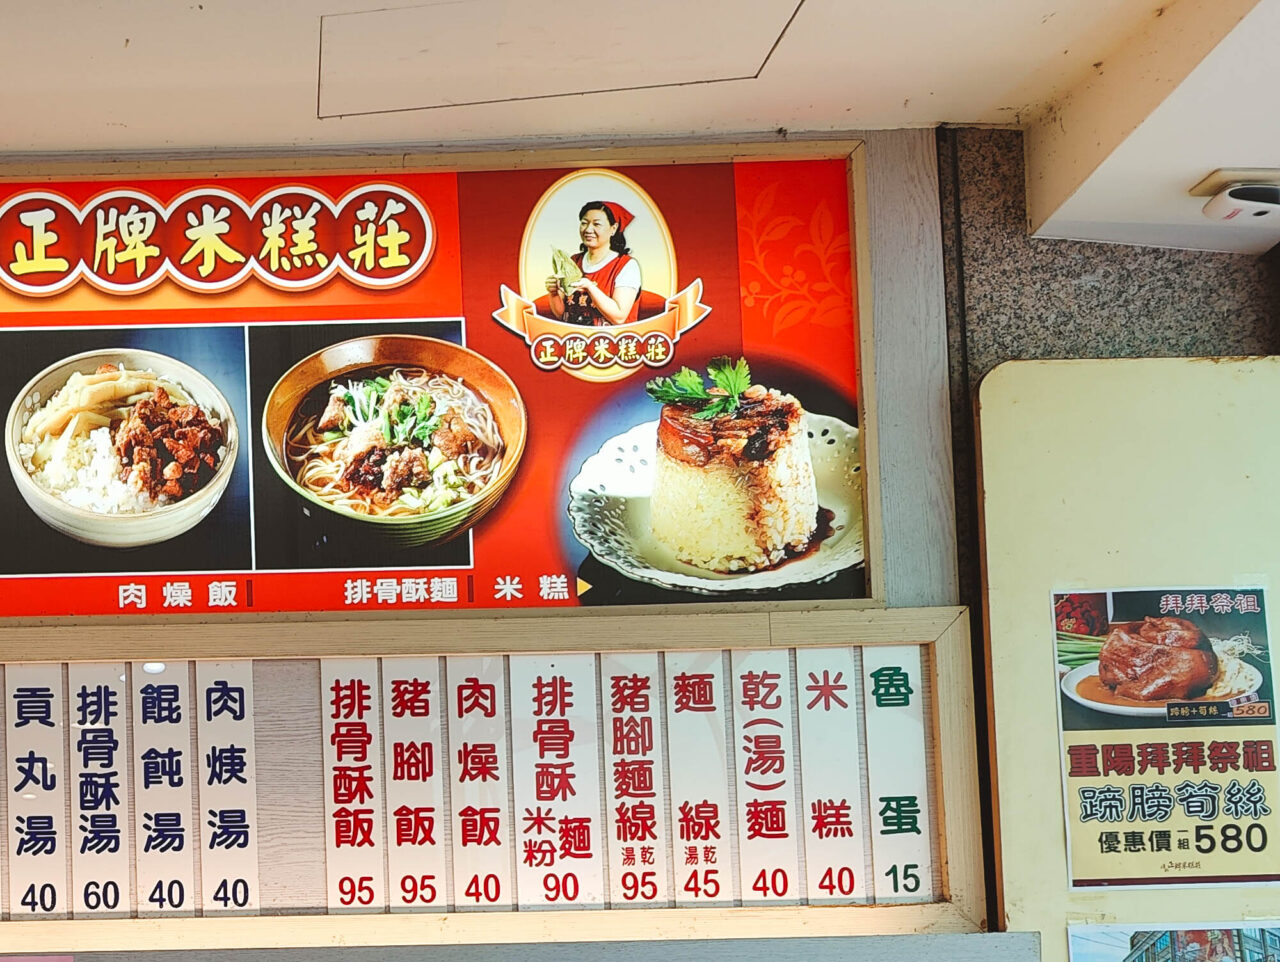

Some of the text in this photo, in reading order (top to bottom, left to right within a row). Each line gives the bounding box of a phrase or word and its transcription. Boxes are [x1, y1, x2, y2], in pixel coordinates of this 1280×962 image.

[8, 198, 412, 278] 正牌米糕莊
[538, 337, 667, 363] 正牌米糕莊
[118, 581, 238, 609] 肉燥飯
[343, 576, 458, 605] 排骨酥麵
[493, 575, 569, 601] 米糕
[1159, 593, 1261, 615] 拜拜祭祖
[1235, 705, 1268, 716] 580
[610, 673, 658, 842] 豬腳麵線
[673, 671, 721, 842] 麵線
[1067, 740, 1277, 778] 重陽拜拜祭祖
[13, 687, 57, 913] 貢丸湯 40
[76, 684, 121, 910] 排骨酥湯 60
[140, 683, 185, 909] 餛飩湯 40
[329, 678, 375, 905] 排骨酥飯 95
[391, 678, 437, 904] 豬腳飯 95
[456, 677, 502, 903] 肉燥飯 40
[522, 675, 593, 902] 排骨酥 米粉 麵 90
[806, 669, 855, 896] 米糕 40
[870, 666, 922, 893] 魯蛋 15
[1078, 779, 1271, 823] 蹄膀筍絲
[1097, 830, 1172, 854] 優惠價
[1194, 823, 1268, 854] 580
[213, 878, 250, 908] 40
[621, 871, 658, 900] 95
[683, 869, 721, 898] 45
[752, 868, 789, 897] 40
